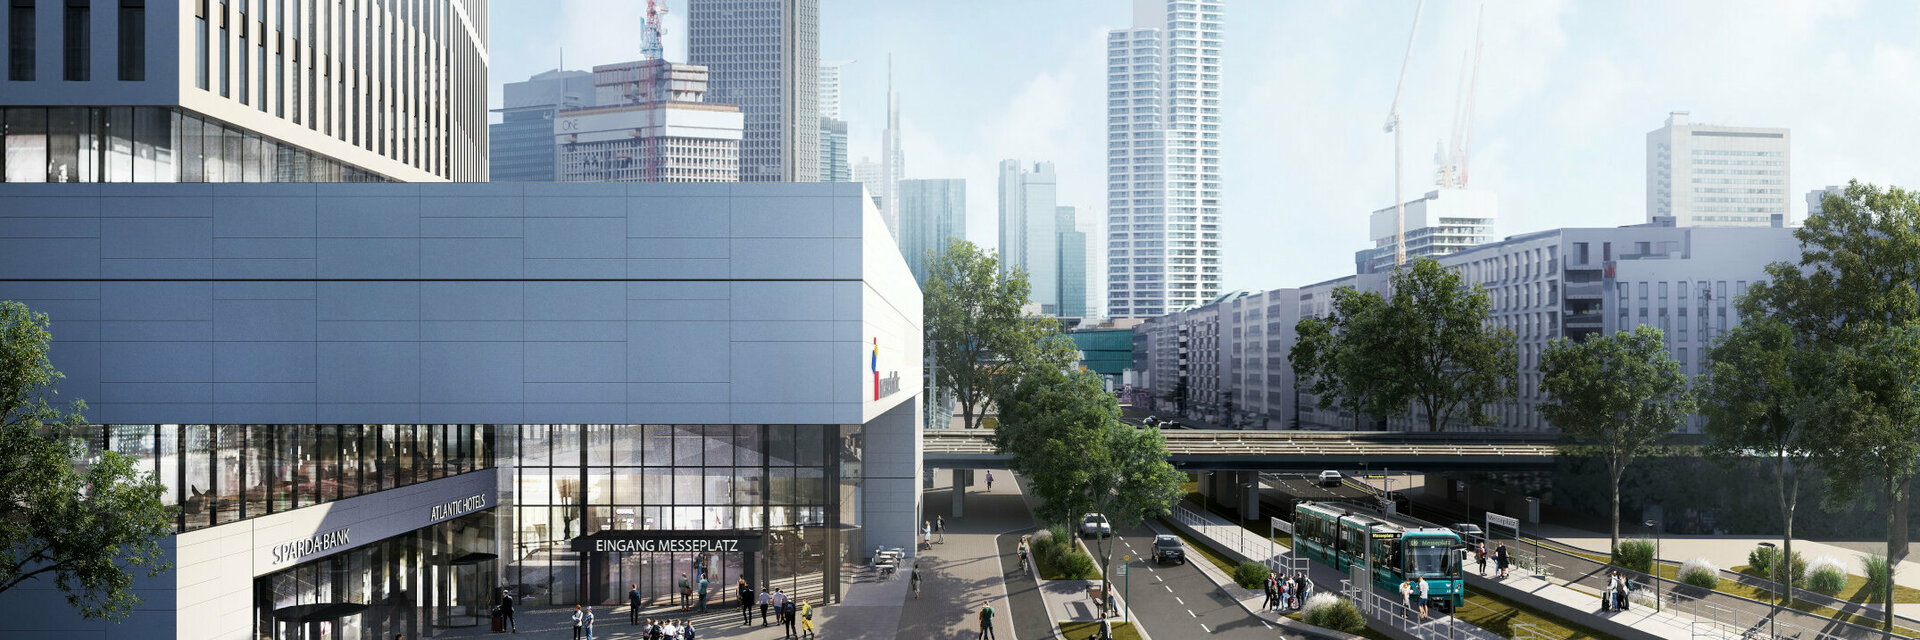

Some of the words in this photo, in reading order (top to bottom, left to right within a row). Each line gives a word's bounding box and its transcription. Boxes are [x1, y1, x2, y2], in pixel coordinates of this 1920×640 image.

[562, 119, 578, 131] ONE
[430, 499, 463, 522] ATLANTIC
[462, 493, 486, 513] HOTELS
[272, 527, 350, 566] SPARDA-BANK
[595, 539, 655, 552] EINGANG
[658, 539, 739, 552] MESSEPLATZ
